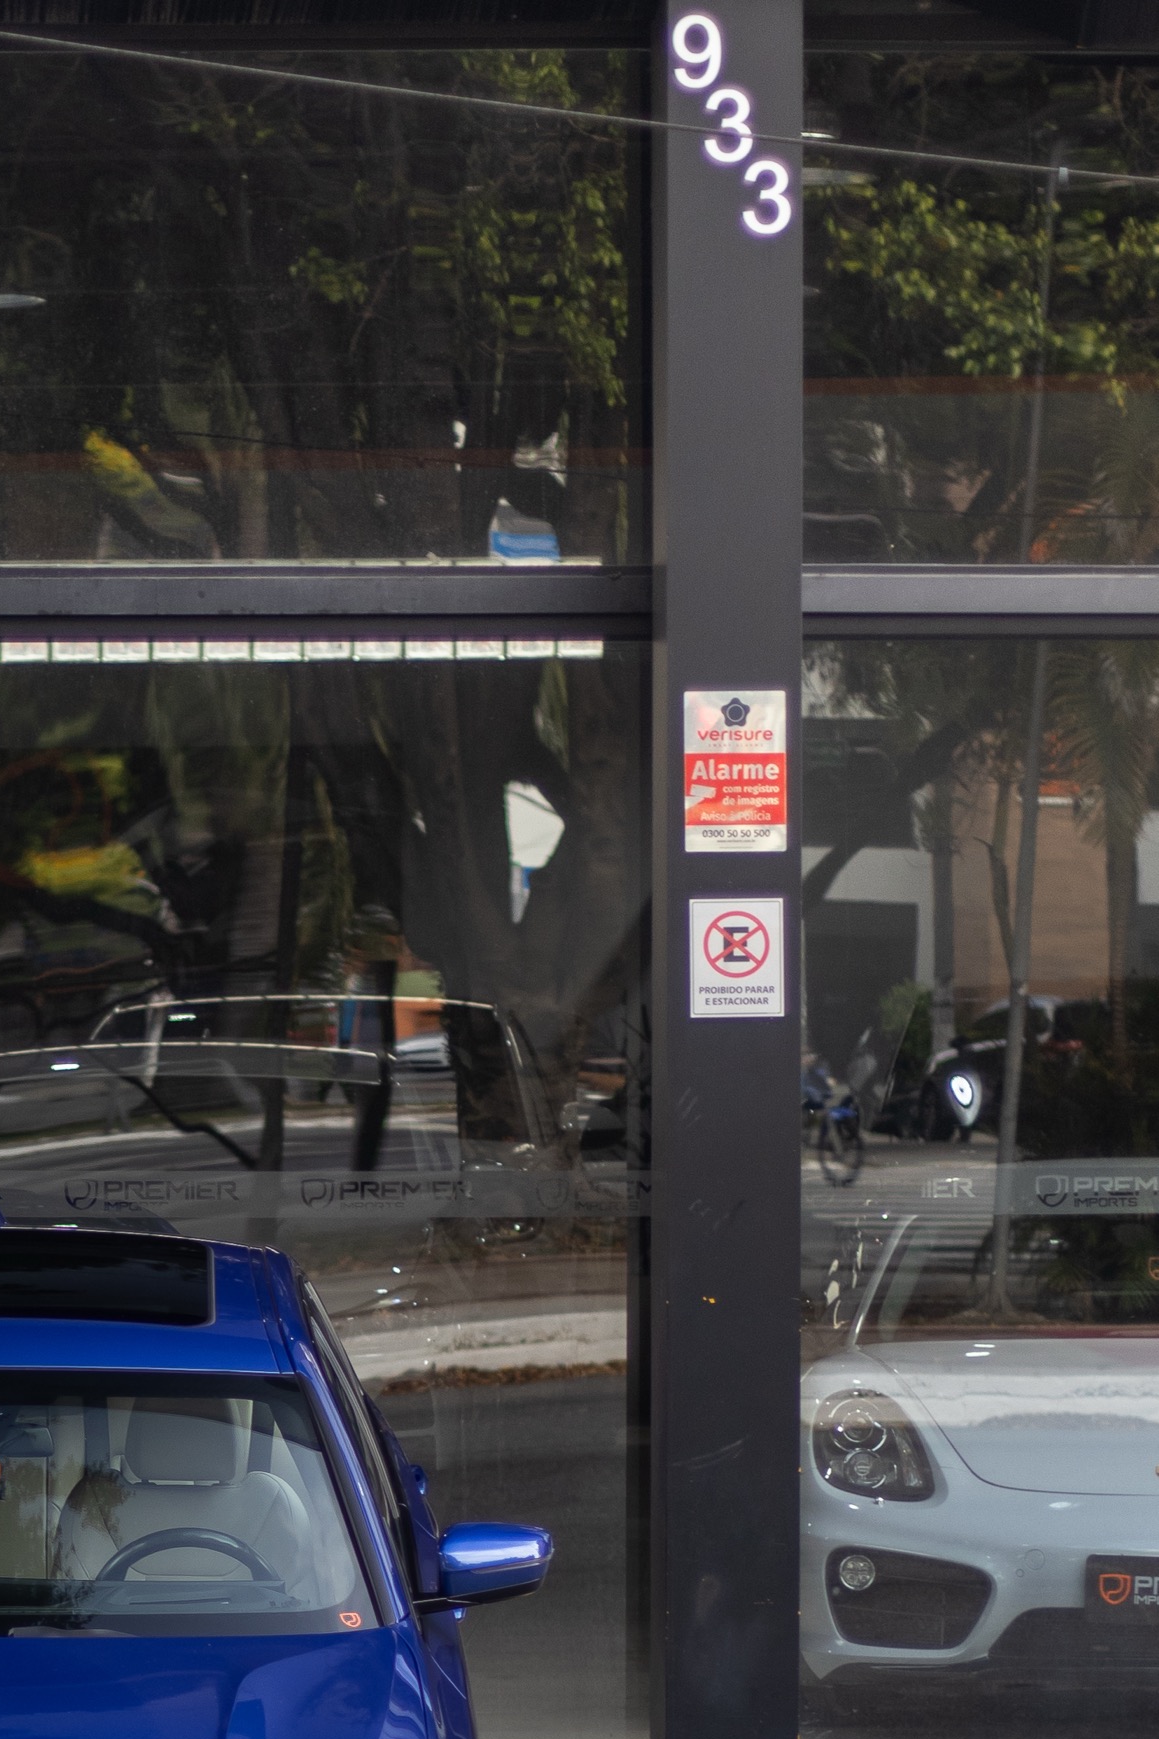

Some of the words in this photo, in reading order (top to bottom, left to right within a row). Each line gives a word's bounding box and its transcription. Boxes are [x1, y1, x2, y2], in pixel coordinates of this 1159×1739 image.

[672, 14, 791, 234] 933
[697, 729, 774, 741] verisure
[691, 759, 780, 780] Alarme
[722, 785, 742, 793] com
[743, 783, 780, 795] registro
[722, 796, 736, 806] de
[737, 795, 780, 807] imagens
[700, 811, 727, 821] Aviso
[702, 829, 725, 838] 0300
[727, 829, 738, 838] 50
[740, 829, 752, 838] 50
[754, 829, 771, 838] 500
[698, 986, 743, 994] PROIBIDO
[744, 985, 775, 994] PARAR
[712, 997, 769, 1005] ESTACIONAR
[103, 1180, 240, 1201] PREMIER
[1073, 1197, 1138, 1207] IMPORTS
[1134, 1595, 1159, 1605] IMP
